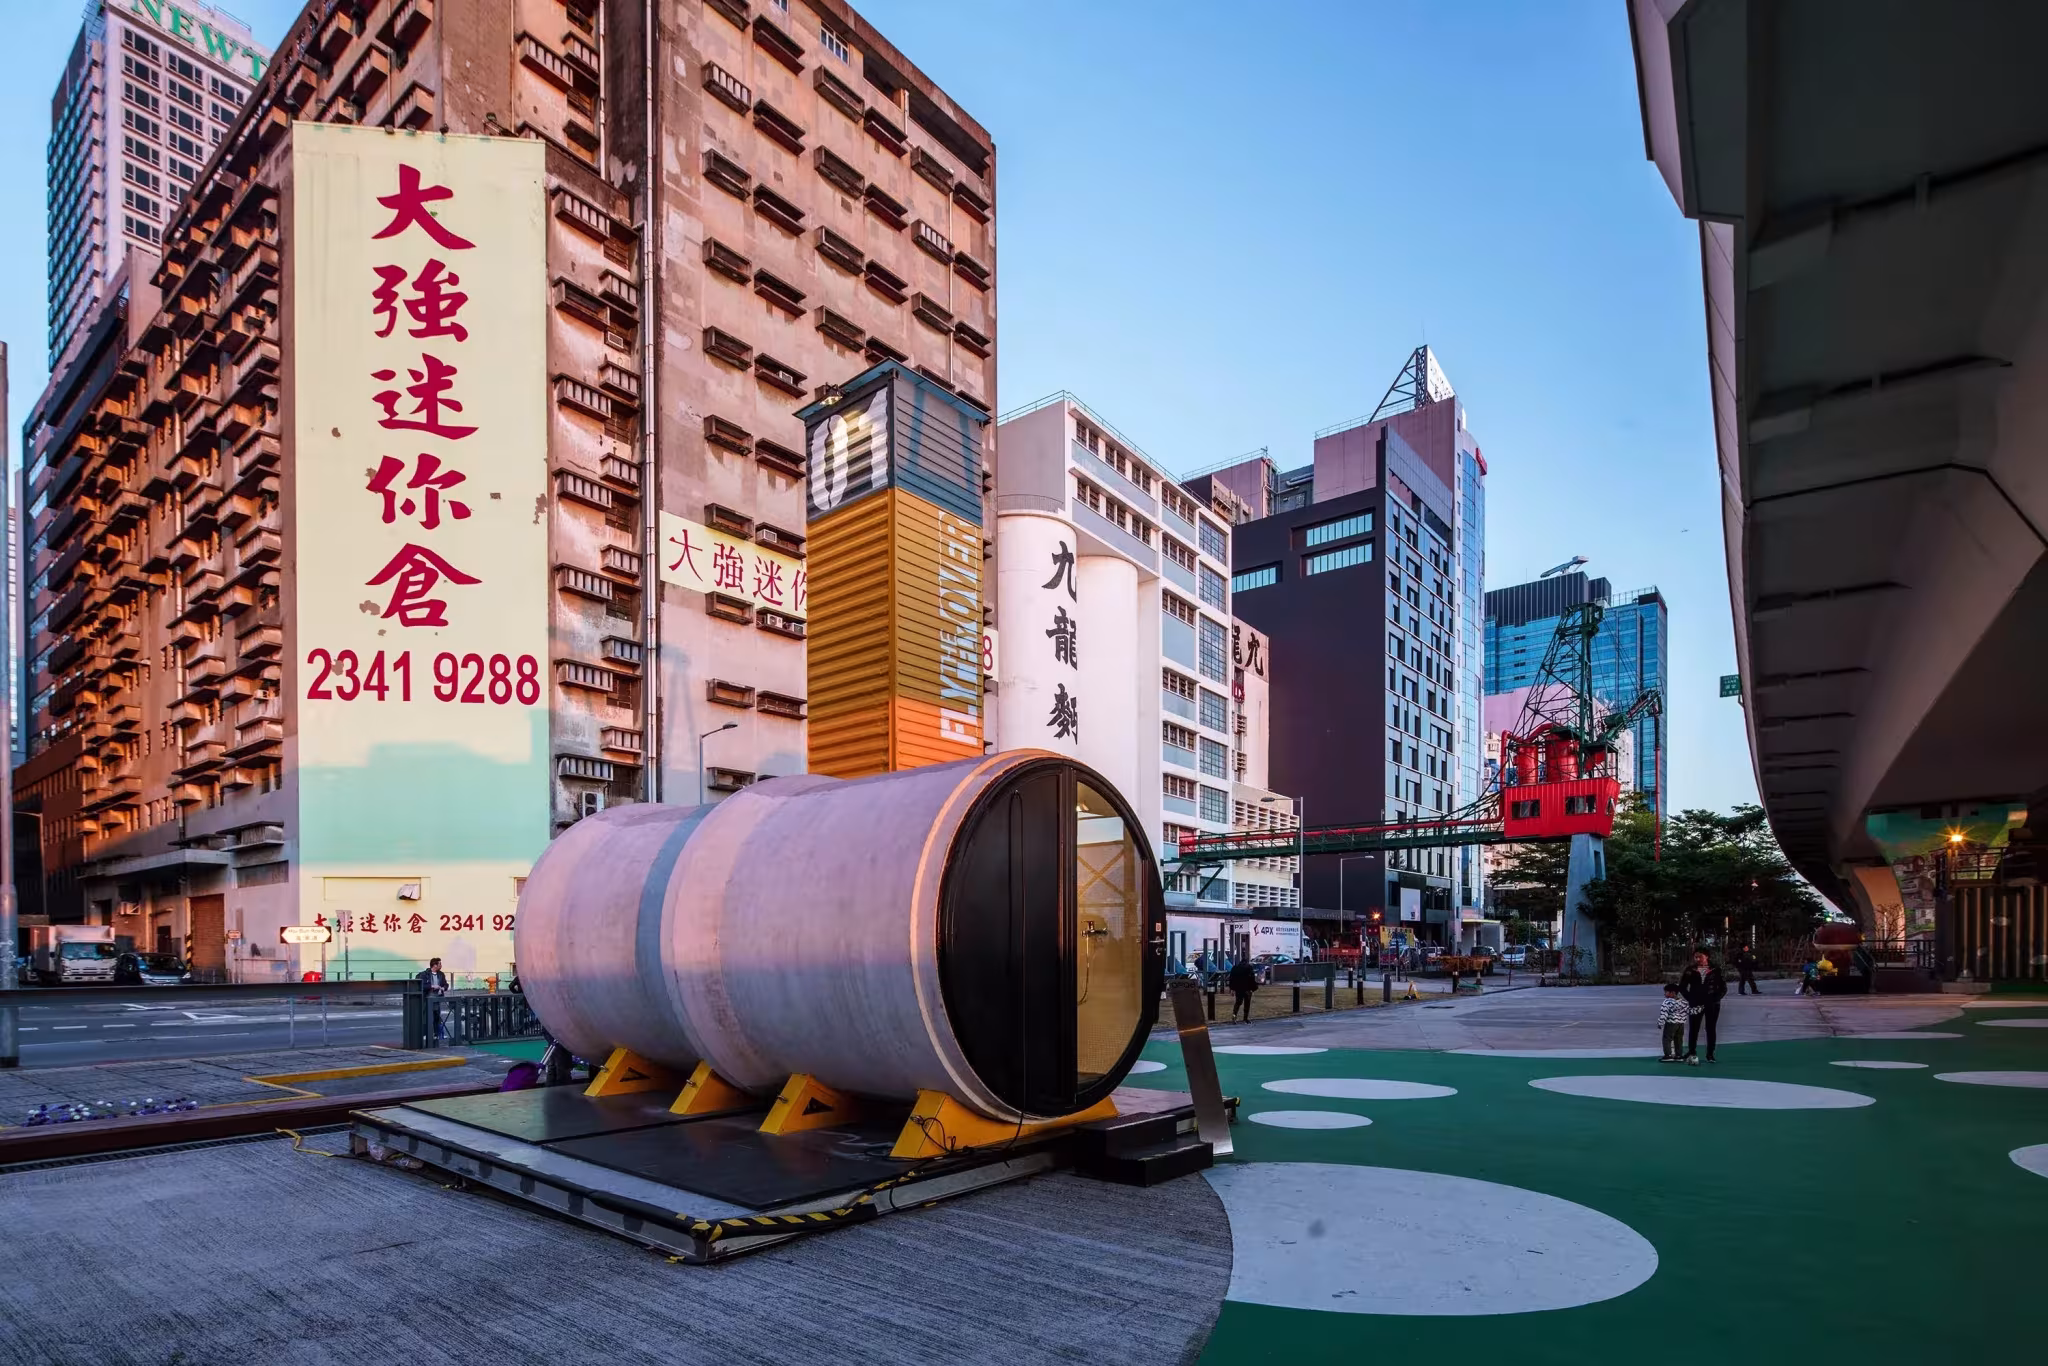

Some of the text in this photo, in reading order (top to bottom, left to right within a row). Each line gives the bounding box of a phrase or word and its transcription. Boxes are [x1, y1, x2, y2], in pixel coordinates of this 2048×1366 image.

[365, 163, 483, 627] 大強迷你倉
[811, 386, 889, 511] 01
[307, 648, 540, 705] 2341 9288
[440, 914, 483, 931] 2341
[1260, 926, 1274, 936] 4PX
